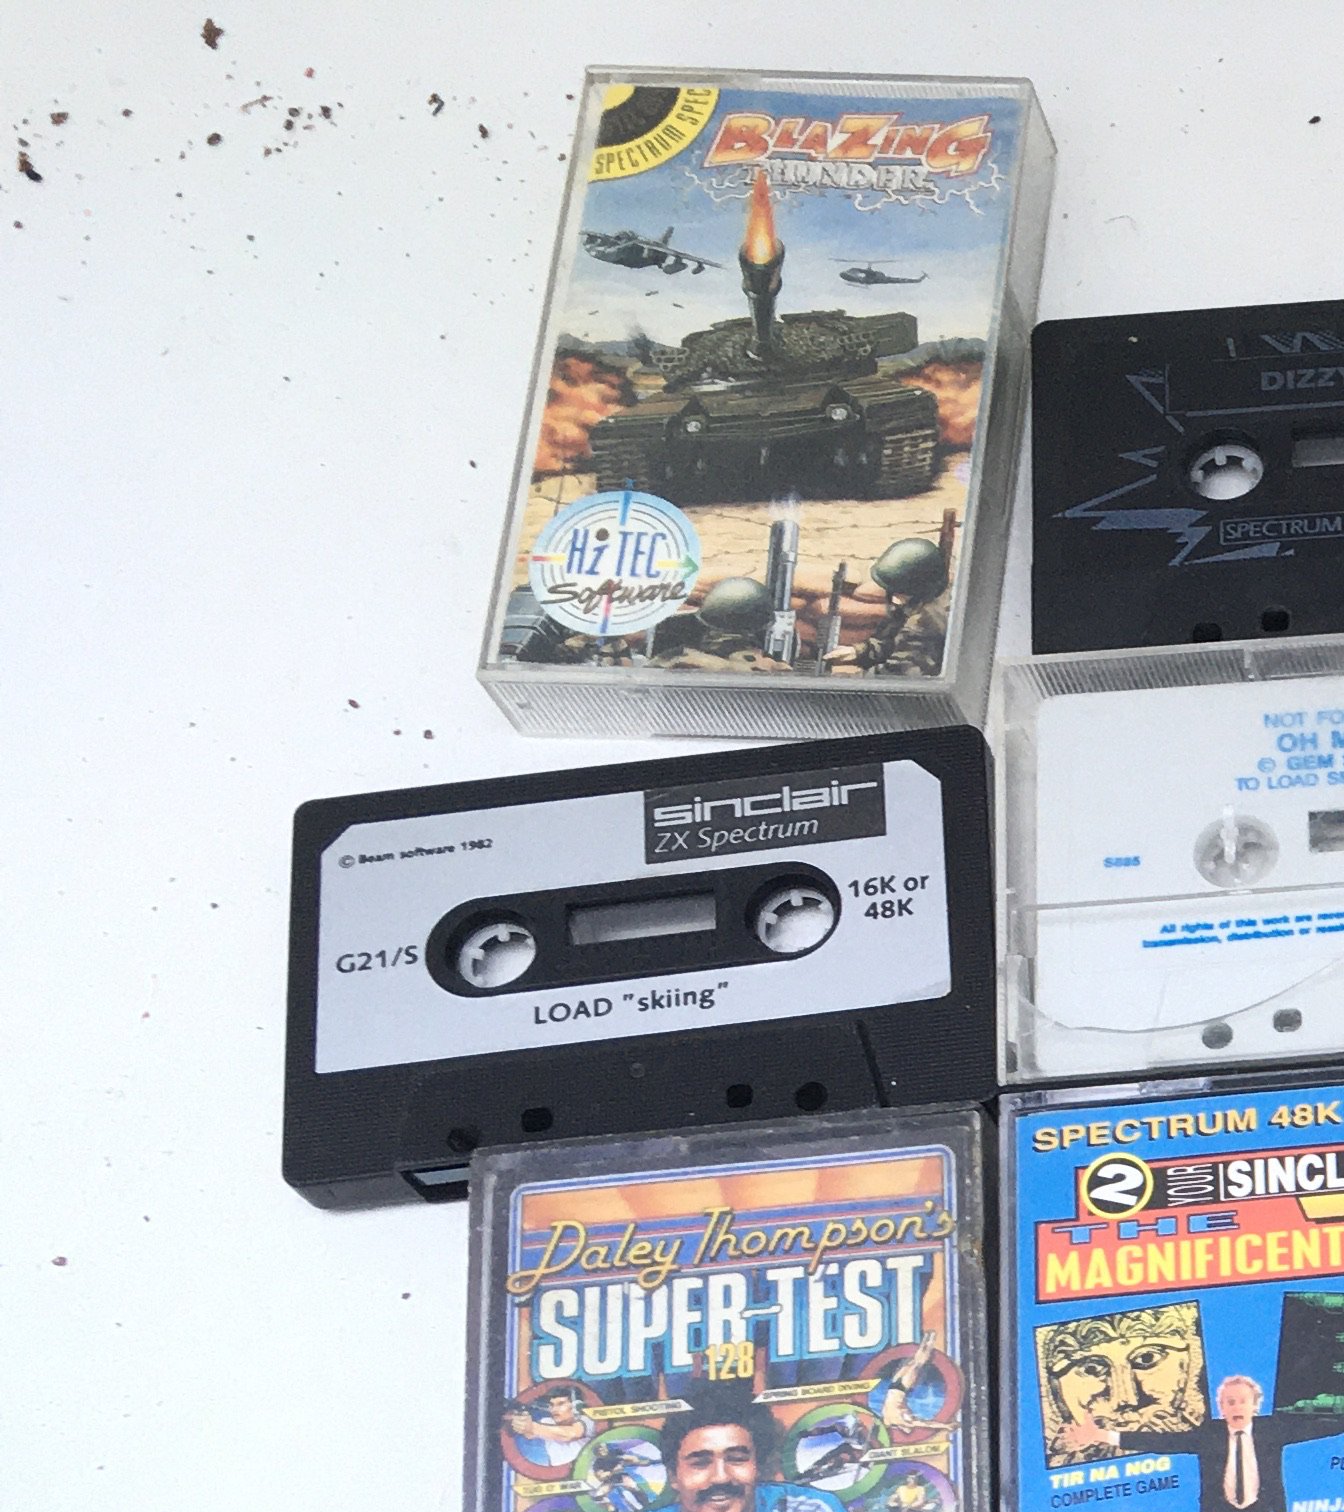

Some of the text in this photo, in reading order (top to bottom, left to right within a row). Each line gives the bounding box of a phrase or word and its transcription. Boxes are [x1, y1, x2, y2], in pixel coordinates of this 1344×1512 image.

[594, 124, 685, 174] SPECTRUM
[1226, 516, 1343, 540] SPECTRUM
[613, 531, 664, 578] TEC
[540, 579, 688, 613] Software
[1277, 731, 1319, 752] OH
[1286, 753, 1335, 770] GEM
[654, 781, 878, 827] sinclair
[654, 817, 818, 854] ZX Spectrum
[849, 873, 929, 896] 16K or
[864, 900, 914, 919] 48K
[336, 946, 418, 974] G21/S
[534, 998, 612, 1025] LOAD
[1032, 1108, 1257, 1153] SPECTRUM
[1270, 1101, 1341, 1128] 48K
[1167, 1164, 1213, 1206] YOUR
[507, 1200, 956, 1293] Daley Thompson's
[704, 1343, 755, 1381] 128
